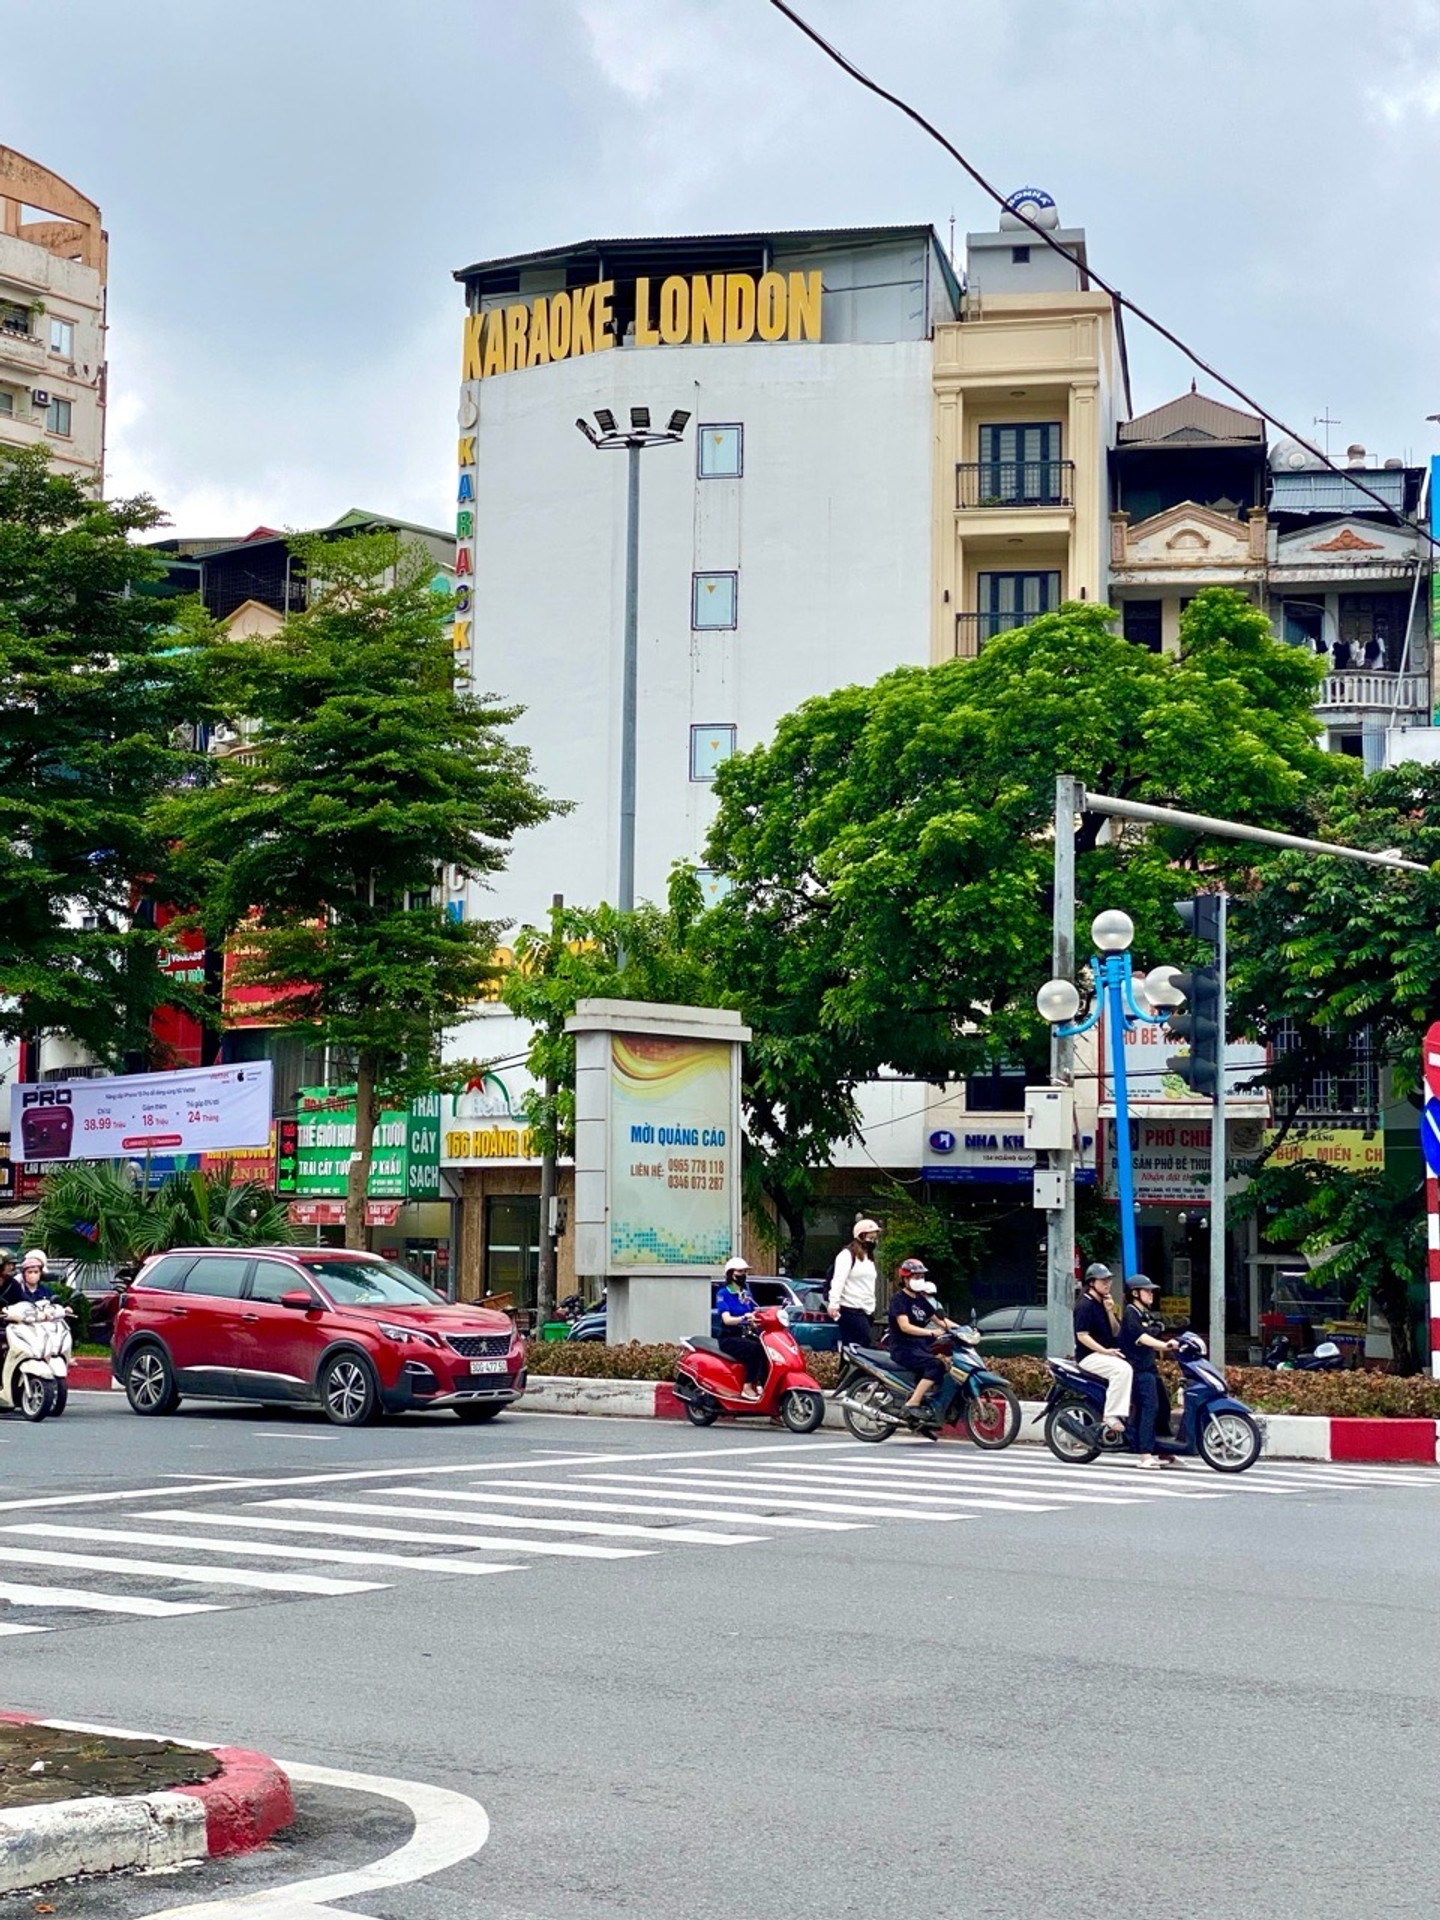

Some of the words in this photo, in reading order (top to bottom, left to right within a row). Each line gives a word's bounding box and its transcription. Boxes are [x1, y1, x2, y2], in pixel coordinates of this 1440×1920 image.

[462, 280, 615, 382] KARAOKE
[634, 271, 822, 346] LONDON
[22, 1088, 72, 1108] PRO
[412, 1090, 439, 1117] TRÁI
[83, 1117, 112, 1131] 38.99
[142, 1114, 154, 1126] 18
[188, 1110, 201, 1123] 24
[297, 1116, 316, 1147] THẾ
[411, 1126, 437, 1154] CÂY
[472, 1123, 519, 1157] HOÀNG
[631, 1122, 654, 1144] MỜI
[658, 1122, 699, 1147] QUẢNG
[702, 1126, 726, 1147] CÁO
[1145, 1124, 1176, 1147] PHỞ
[964, 1134, 998, 1149] NHA
[1316, 1143, 1352, 1161] MIẾN
[298, 1157, 316, 1176] TRÁI
[630, 1162, 650, 1176] LIÊN
[651, 1162, 664, 1180] HỆ:
[668, 1158, 689, 1173] 0965
[709, 1160, 724, 1174] 118
[1133, 1154, 1152, 1170] SẢN
[1154, 1154, 1173, 1170] PHỞ
[409, 1164, 439, 1193] SẠCH
[691, 1176, 707, 1190] 073
[1141, 1172, 1165, 1182] Nhận
